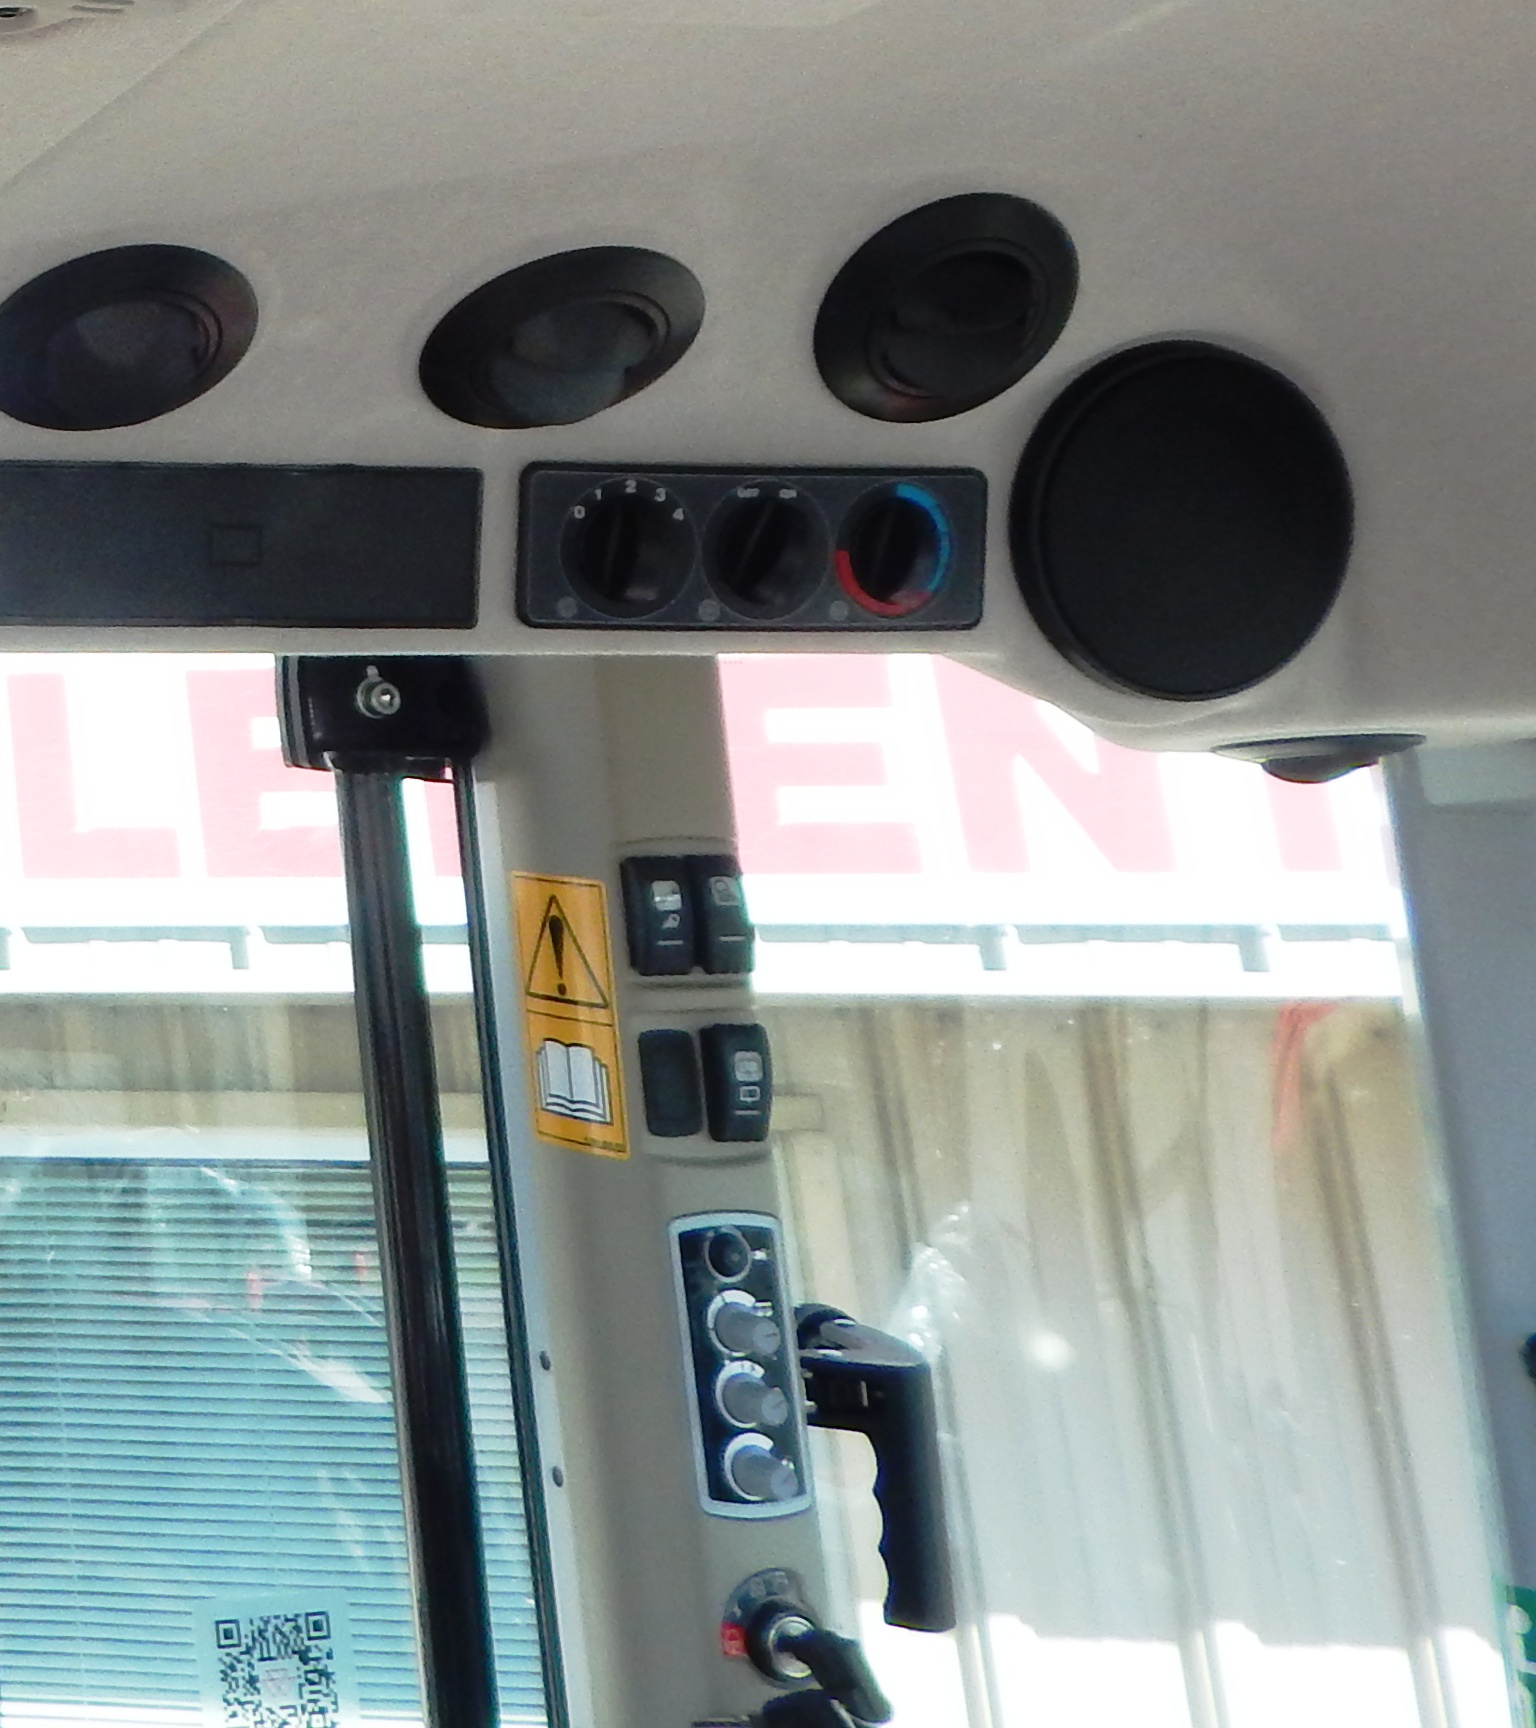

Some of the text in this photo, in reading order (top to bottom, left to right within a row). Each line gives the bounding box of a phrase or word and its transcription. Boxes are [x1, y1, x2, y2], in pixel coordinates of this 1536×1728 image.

[573, 479, 685, 521] 0 1 2 3 4
